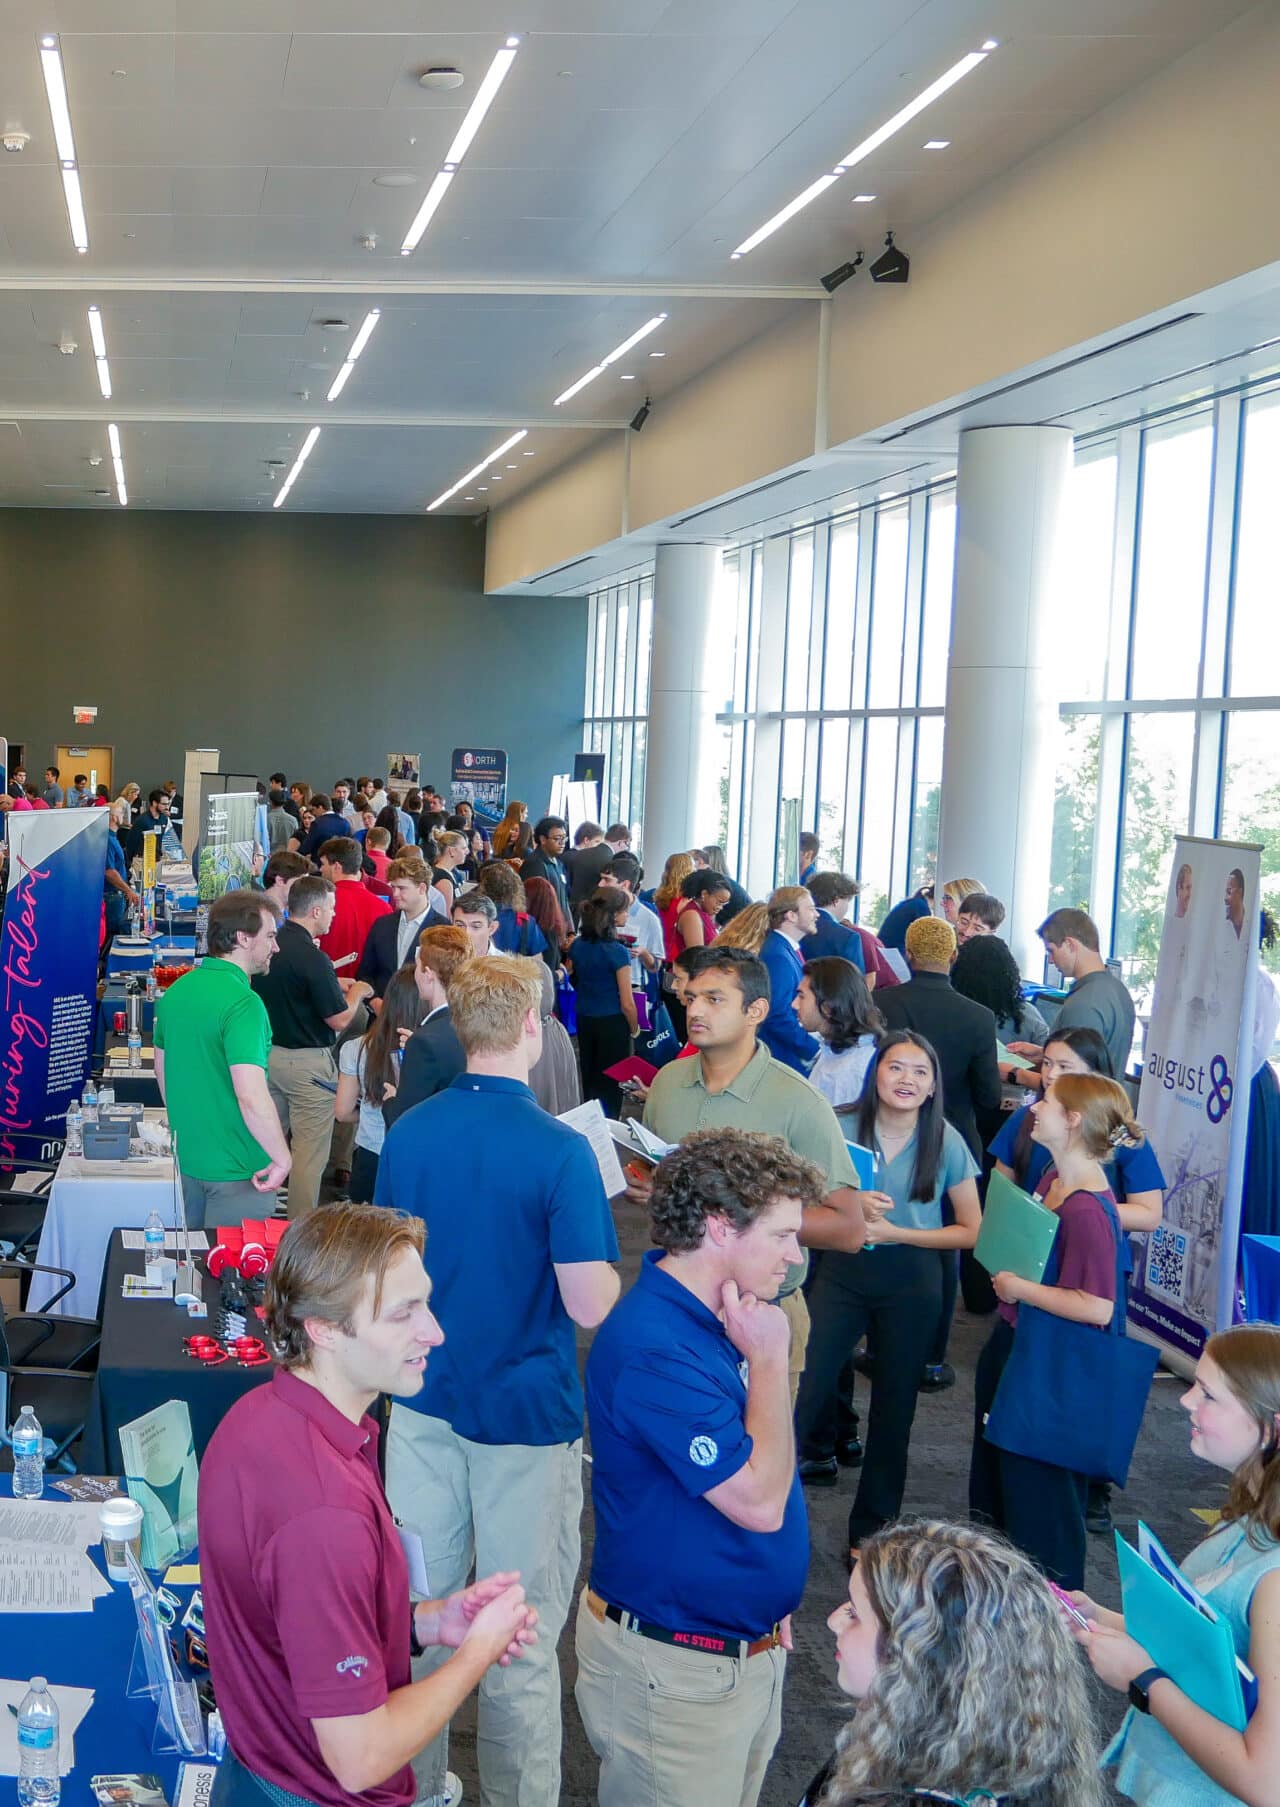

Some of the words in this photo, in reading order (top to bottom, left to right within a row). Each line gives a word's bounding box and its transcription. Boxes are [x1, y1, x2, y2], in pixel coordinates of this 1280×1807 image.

[4, 845, 51, 1011] talent
[1149, 1053, 1205, 1095] august
[41, 1141, 64, 1160] nn
[1181, 1327, 1200, 1347] Impact
[673, 1631, 690, 1644] NC
[691, 1634, 725, 1651] STATE
[336, 1655, 368, 1672] Callaway
[193, 1772, 212, 1807] onesis
